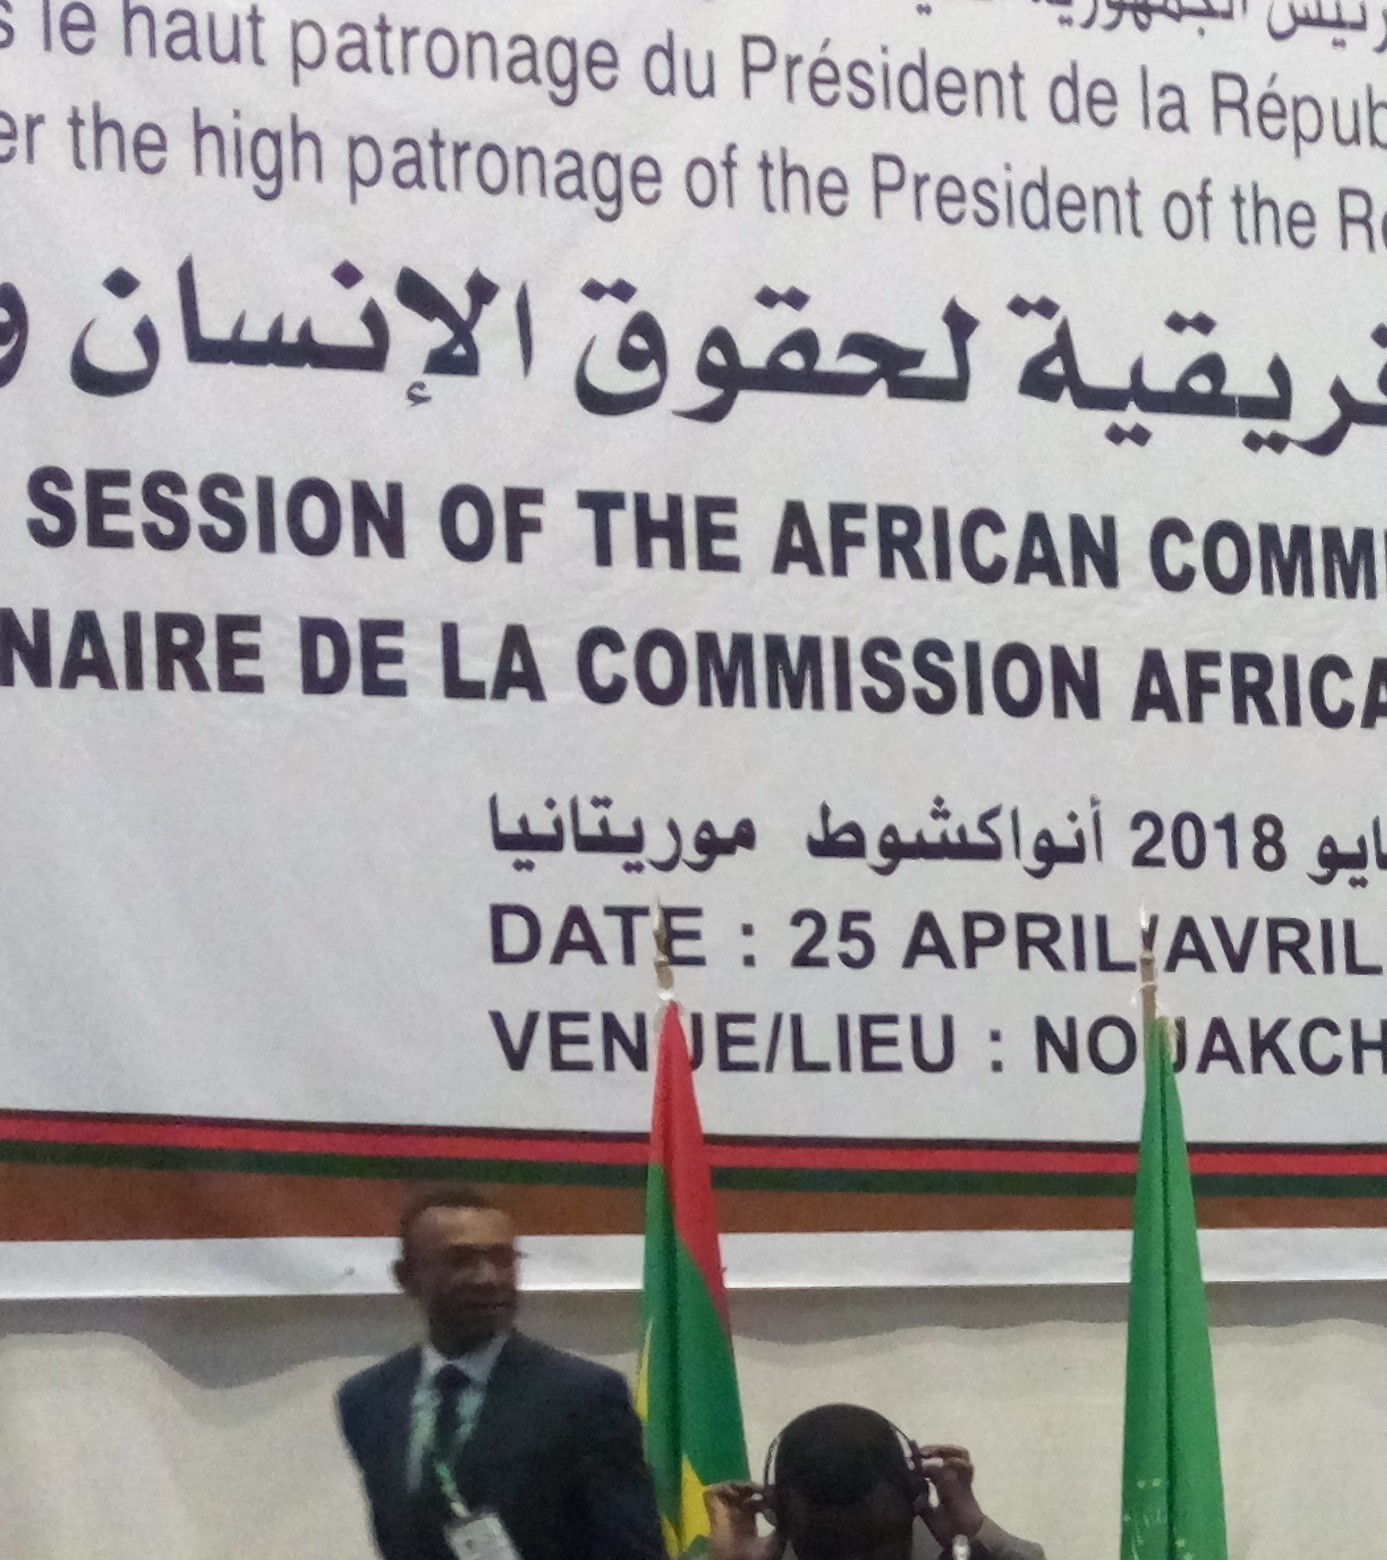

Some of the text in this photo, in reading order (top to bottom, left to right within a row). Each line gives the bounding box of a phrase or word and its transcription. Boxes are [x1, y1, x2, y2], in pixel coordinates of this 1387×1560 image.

[43, 0, 96, 55] le
[123, 0, 265, 66] haut
[292, 13, 618, 107] patronage
[644, 29, 715, 98] du
[742, 35, 1026, 121] Président
[1050, 61, 1117, 127] de
[1141, 65, 1189, 133] la
[68, 101, 167, 175] the
[193, 107, 322, 201] high
[348, 128, 662, 222] patronage
[686, 143, 737, 208] of
[758, 147, 848, 217] the
[873, 153, 1142, 238] President
[1164, 178, 1212, 241] of
[1231, 182, 1316, 249] the
[70, 254, 533, 407] الإنسان
[575, 278, 980, 424] لحقوق
[27, 466, 405, 559] SESSION
[439, 484, 544, 564] OF
[576, 490, 741, 573] THE
[772, 500, 1119, 589] AFRICAN
[299, 616, 407, 697] DE
[441, 622, 547, 702] LA
[576, 626, 1100, 720] COMMISSION
[489, 793, 756, 874] موريتانيا
[806, 795, 1103, 880] أنواكشوط
[1130, 810, 1287, 872] 2018
[489, 902, 706, 967] DATE
[790, 909, 875, 970] 25
